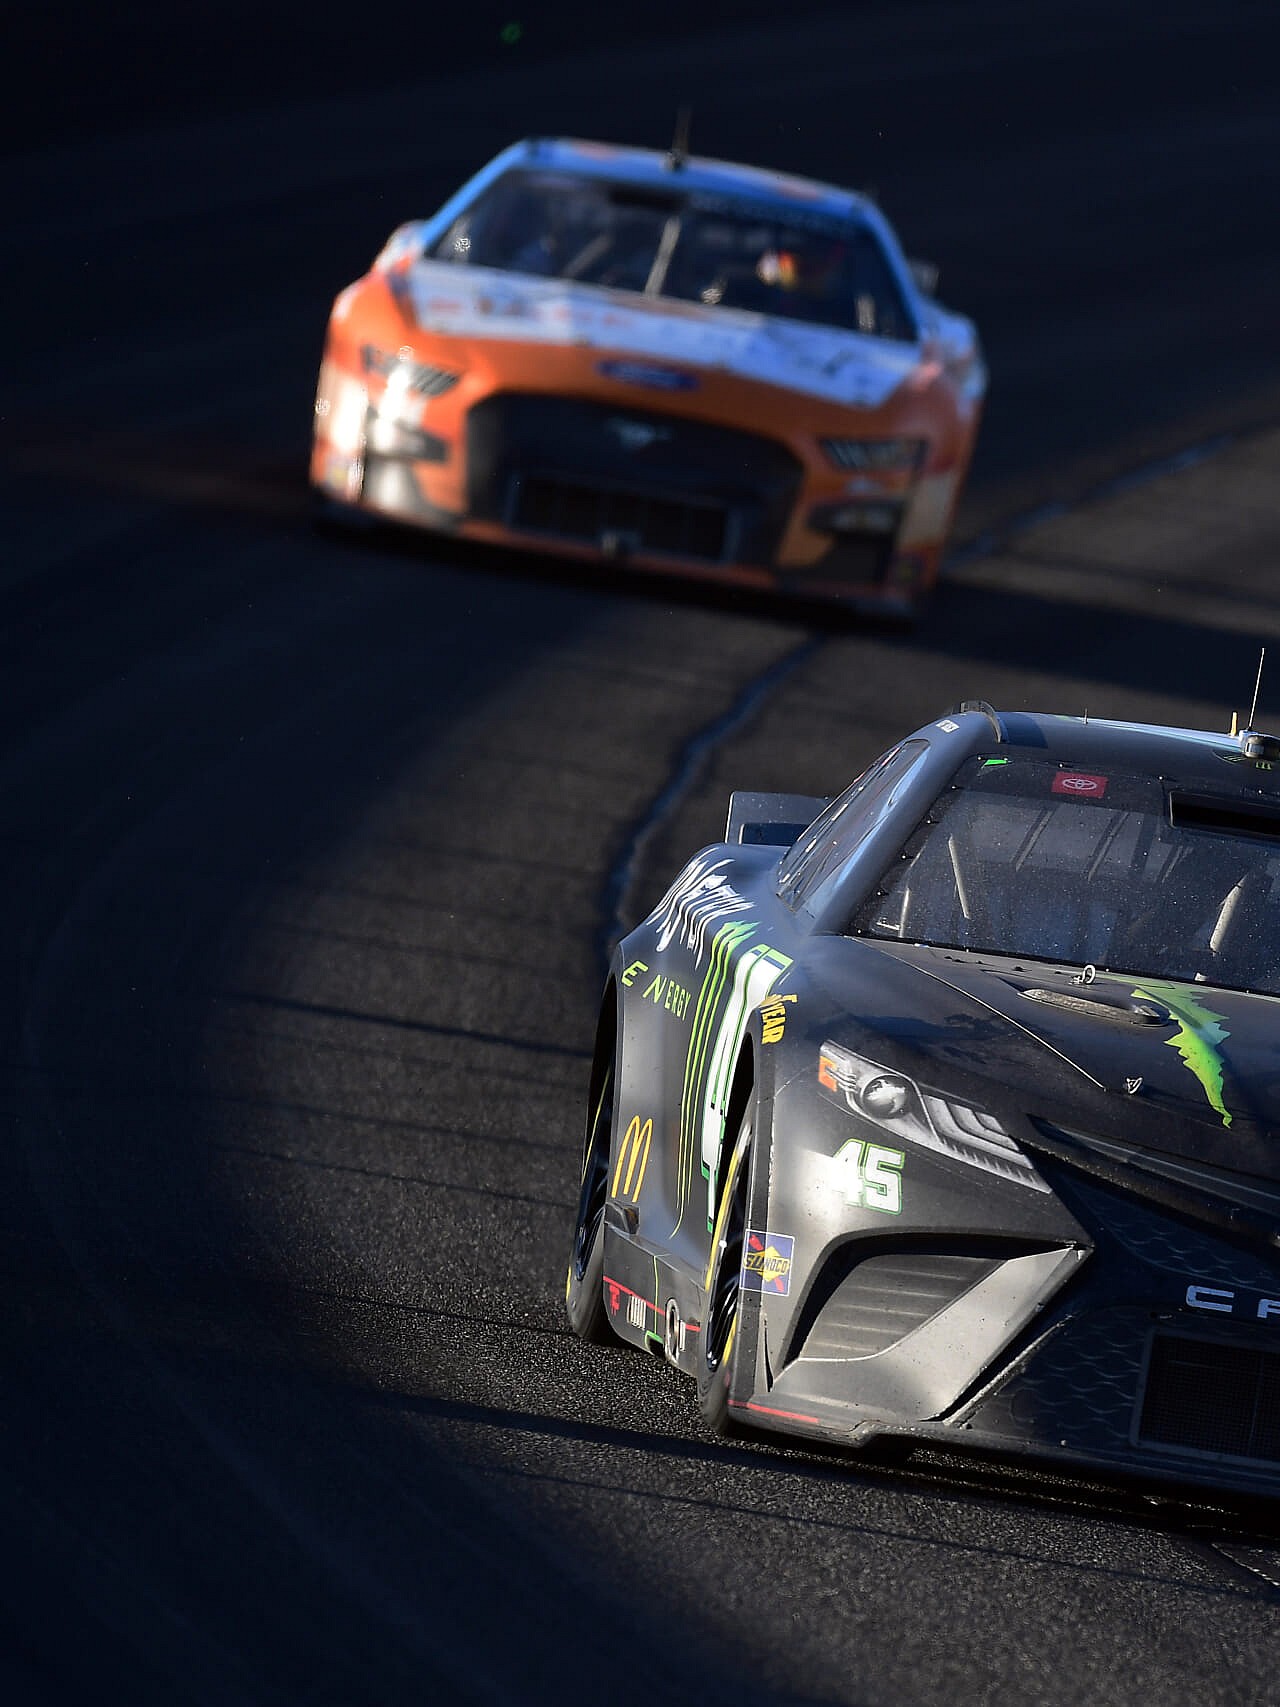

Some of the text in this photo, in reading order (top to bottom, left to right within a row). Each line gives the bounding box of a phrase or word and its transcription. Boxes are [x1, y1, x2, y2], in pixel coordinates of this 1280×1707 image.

[621, 960, 692, 1021] ENERGY
[822, 1138, 906, 1216] 45
[744, 1253, 790, 1275] SUNOCO
